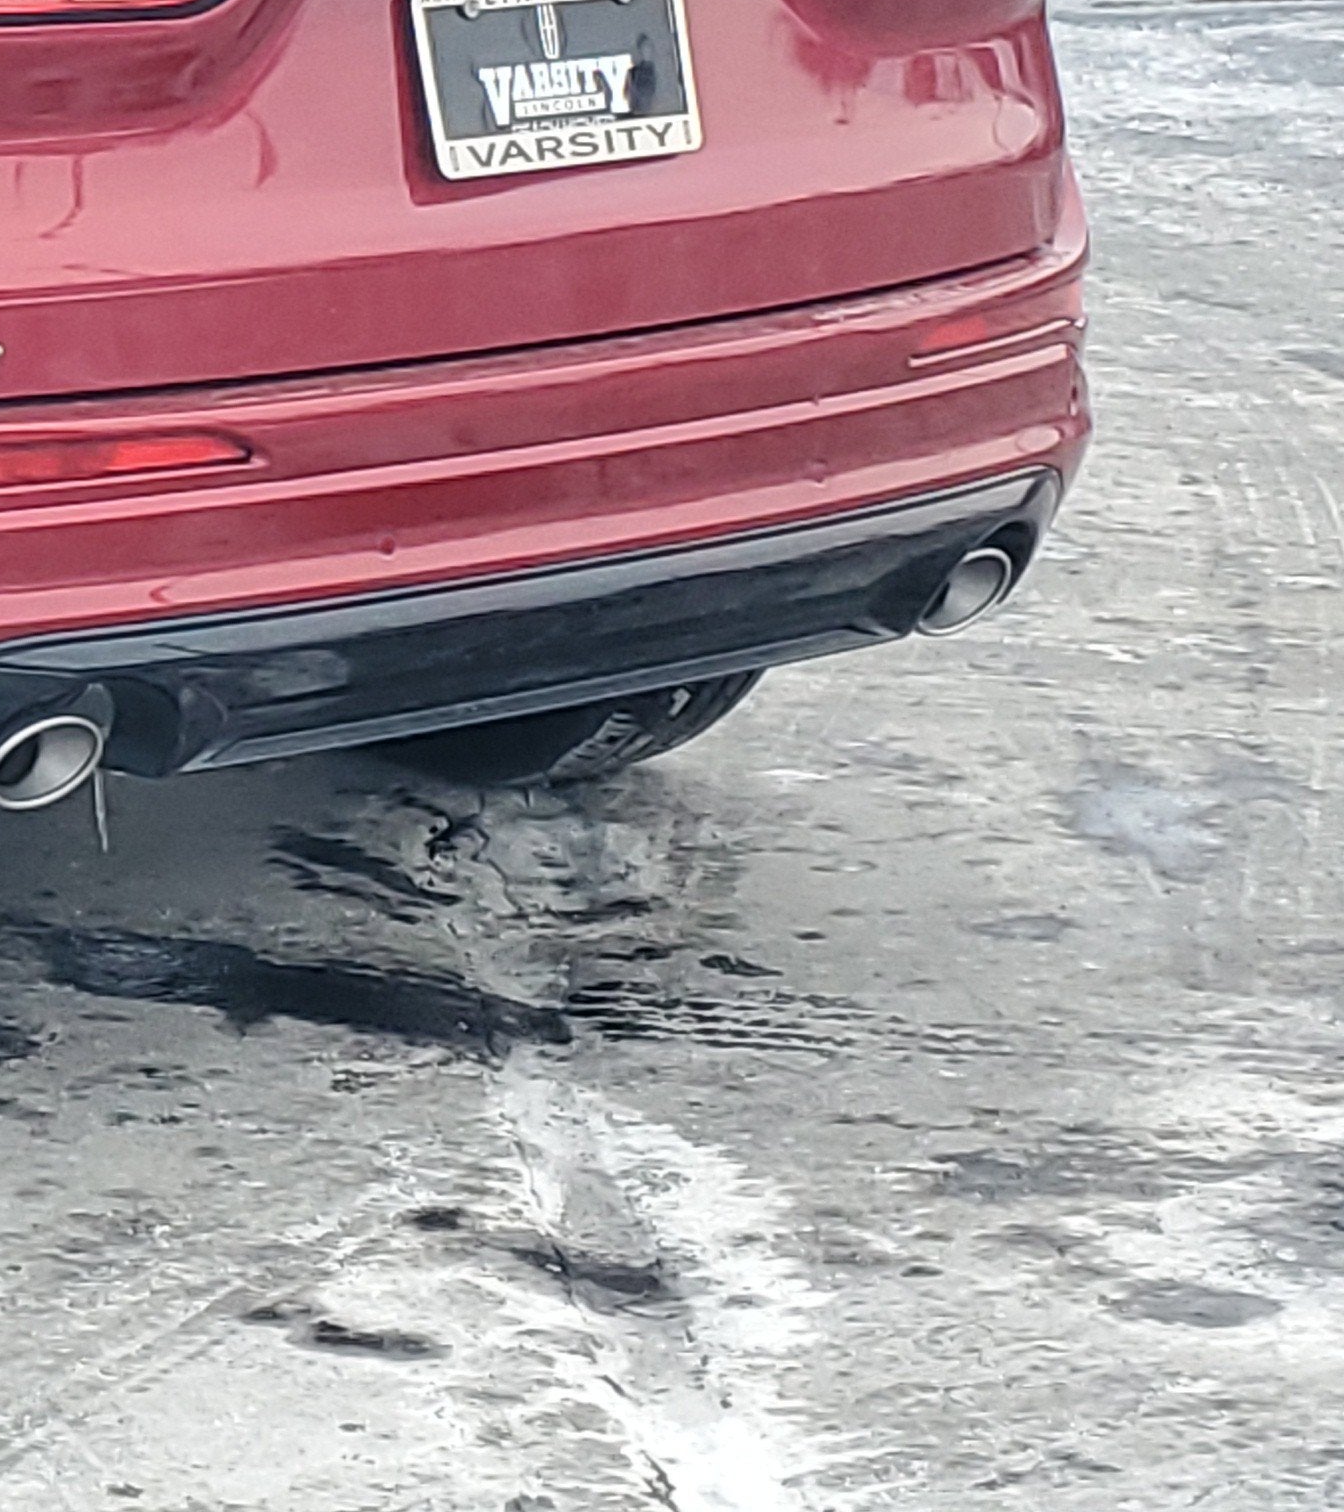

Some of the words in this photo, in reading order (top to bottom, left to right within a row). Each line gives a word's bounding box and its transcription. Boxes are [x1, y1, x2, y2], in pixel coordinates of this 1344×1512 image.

[478, 54, 634, 128] VARSITY
[523, 96, 598, 116] LINCOLN
[467, 122, 673, 168] VARSITY
